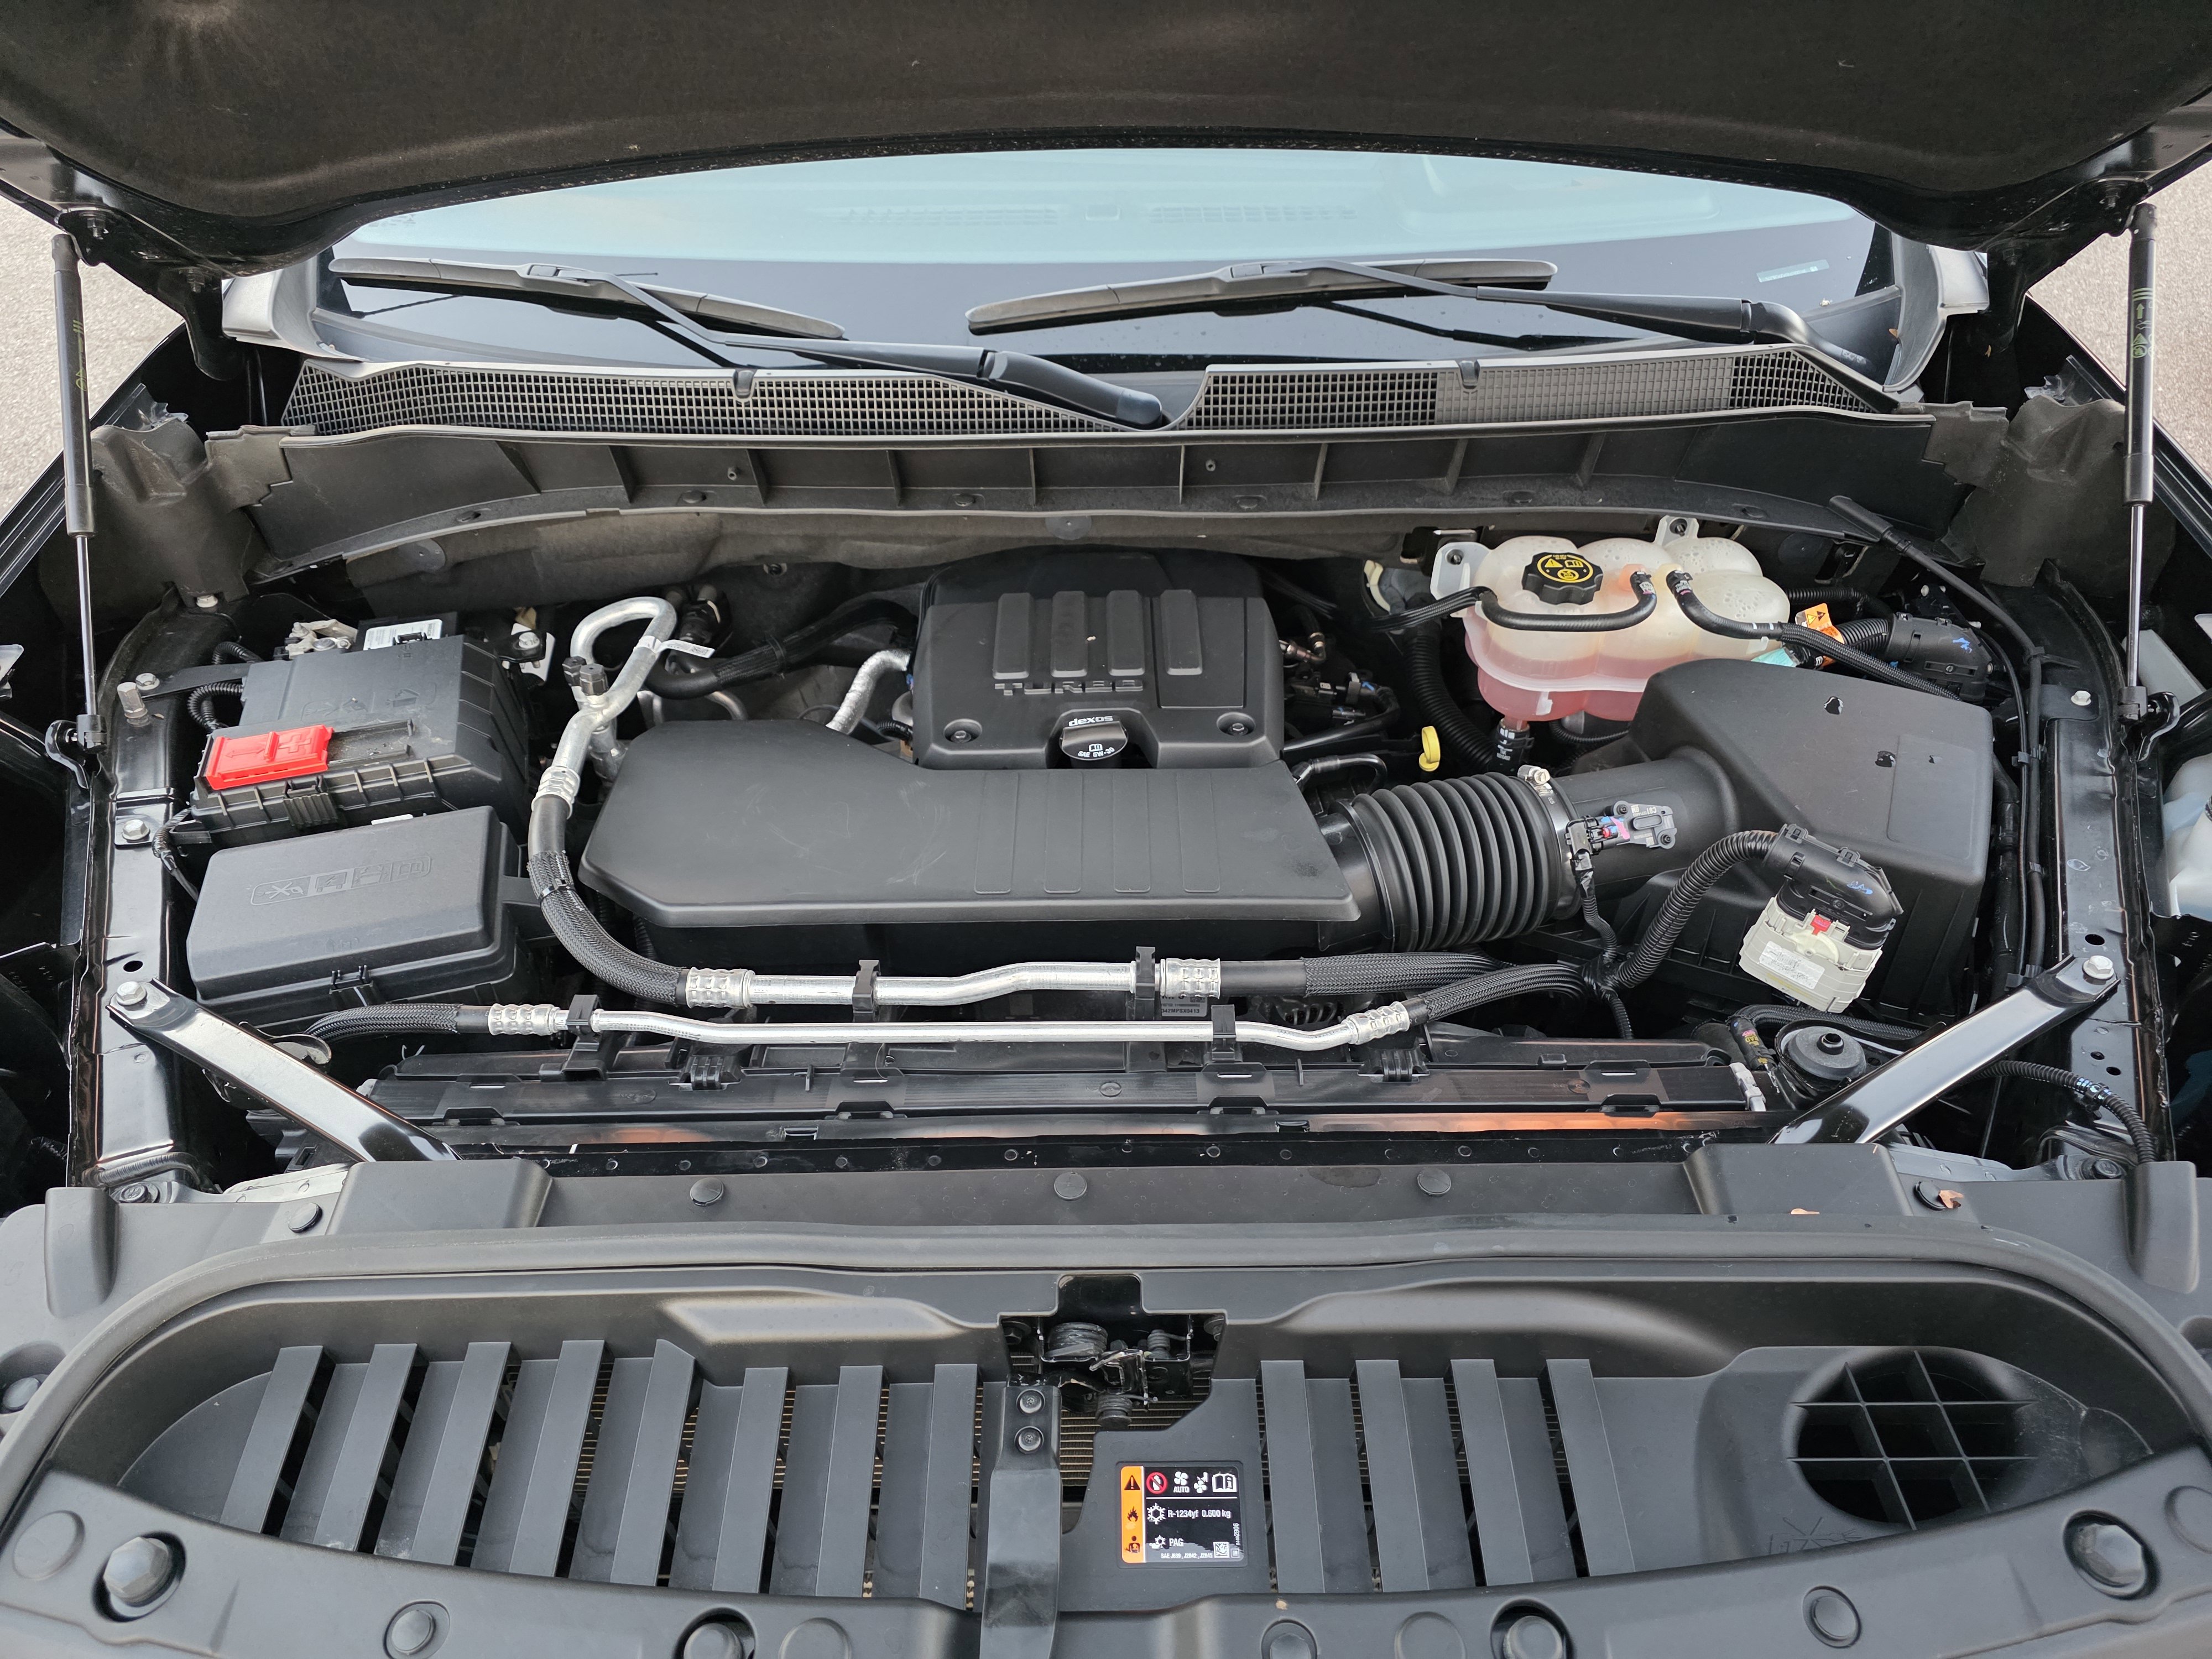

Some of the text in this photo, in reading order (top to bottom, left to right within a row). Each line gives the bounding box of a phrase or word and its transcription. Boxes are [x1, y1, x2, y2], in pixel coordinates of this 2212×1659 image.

[1068, 716, 1113, 727] dexos
[1093, 747, 1115, 758] 5W-30
[1167, 1510, 1199, 1519] R-1234yf
[1222, 1509, 1232, 1519] kg
[1169, 1538, 1184, 1547] PAG
